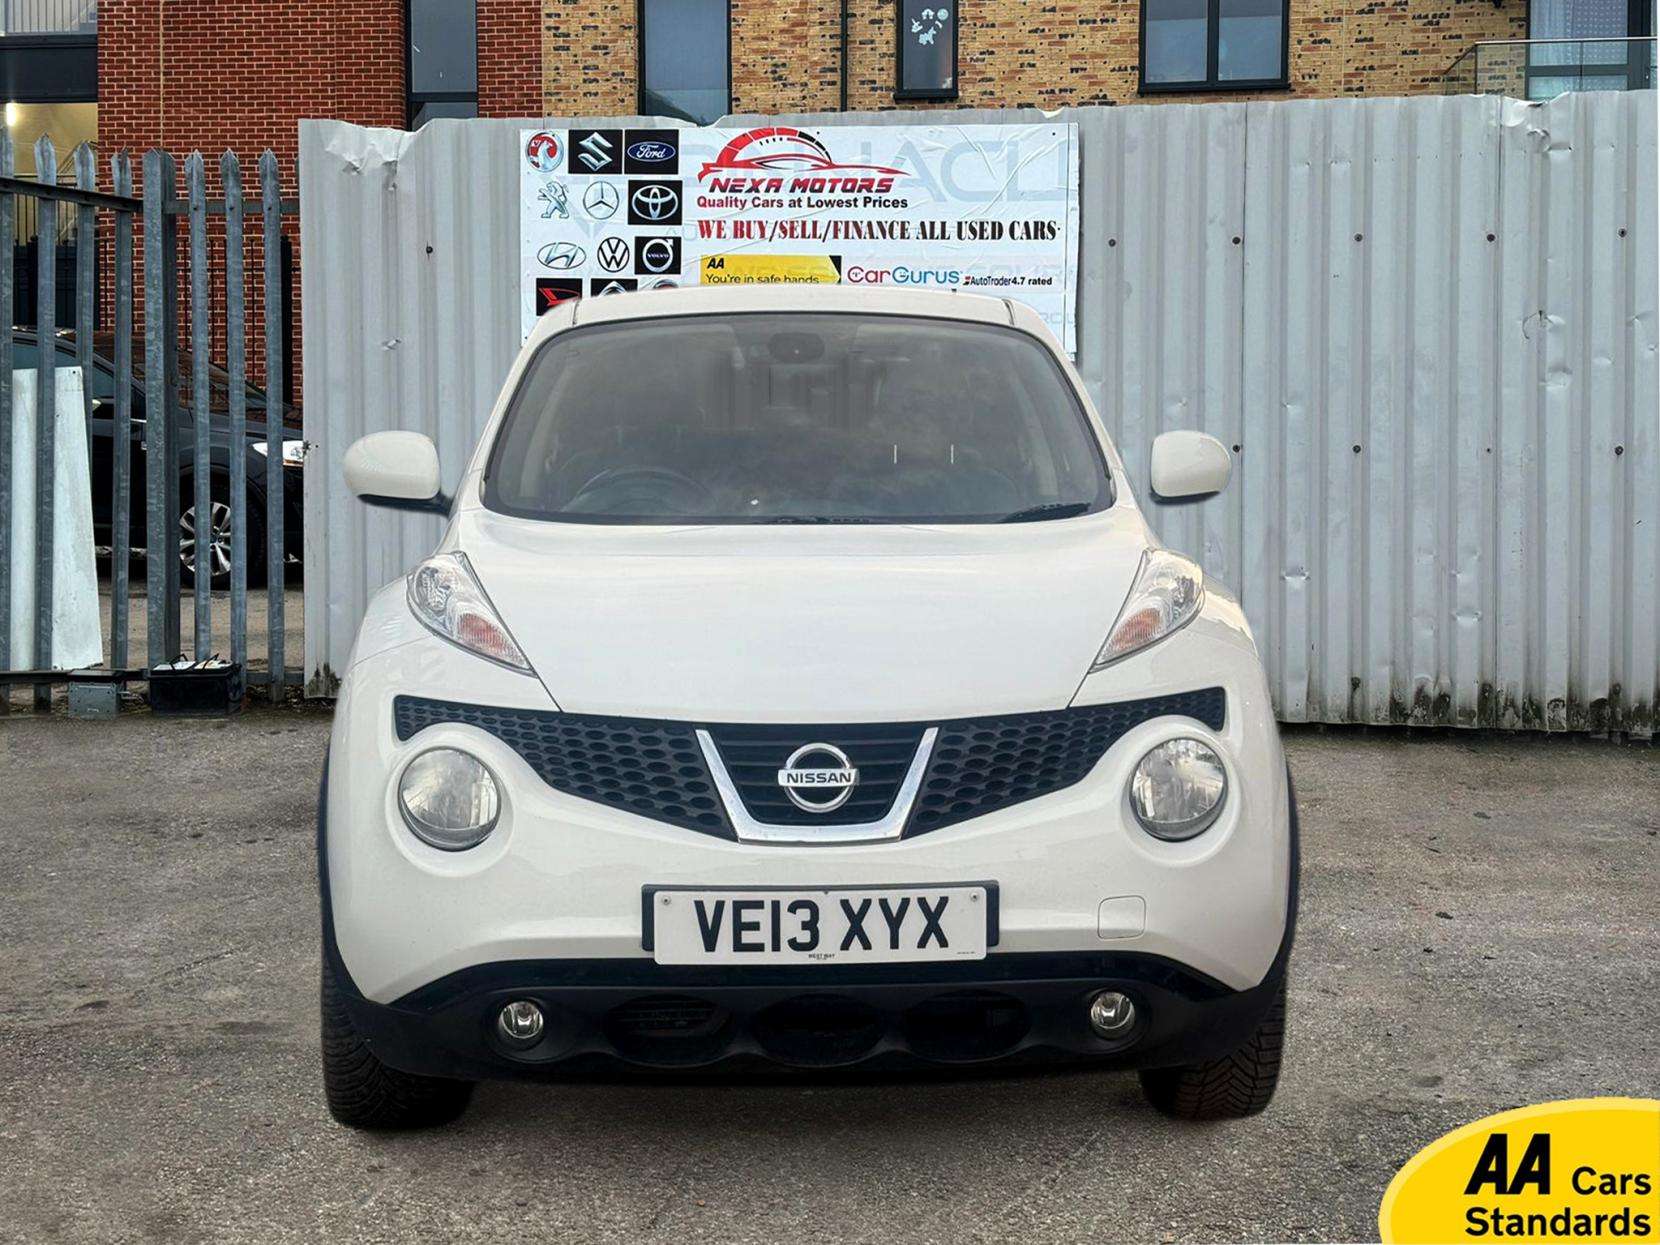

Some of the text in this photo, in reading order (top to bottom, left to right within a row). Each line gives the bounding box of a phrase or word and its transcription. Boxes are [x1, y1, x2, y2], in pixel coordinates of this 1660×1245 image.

[636, 143, 666, 159] Ford
[709, 177, 895, 194] NEXA MOTORS
[696, 195, 908, 211] Quality Cars at Lowest Prices
[697, 220, 727, 240] WE
[915, 221, 951, 240] ALL
[956, 221, 1004, 240] USED
[1008, 221, 1058, 240] CARS
[707, 258, 725, 269] AA
[706, 273, 820, 284] You're in safe hands
[848, 266, 960, 285] CarGurus
[1028, 276, 1053, 286] rated
[786, 772, 852, 784] NISSAN
[693, 896, 949, 953] VE13 XYX
